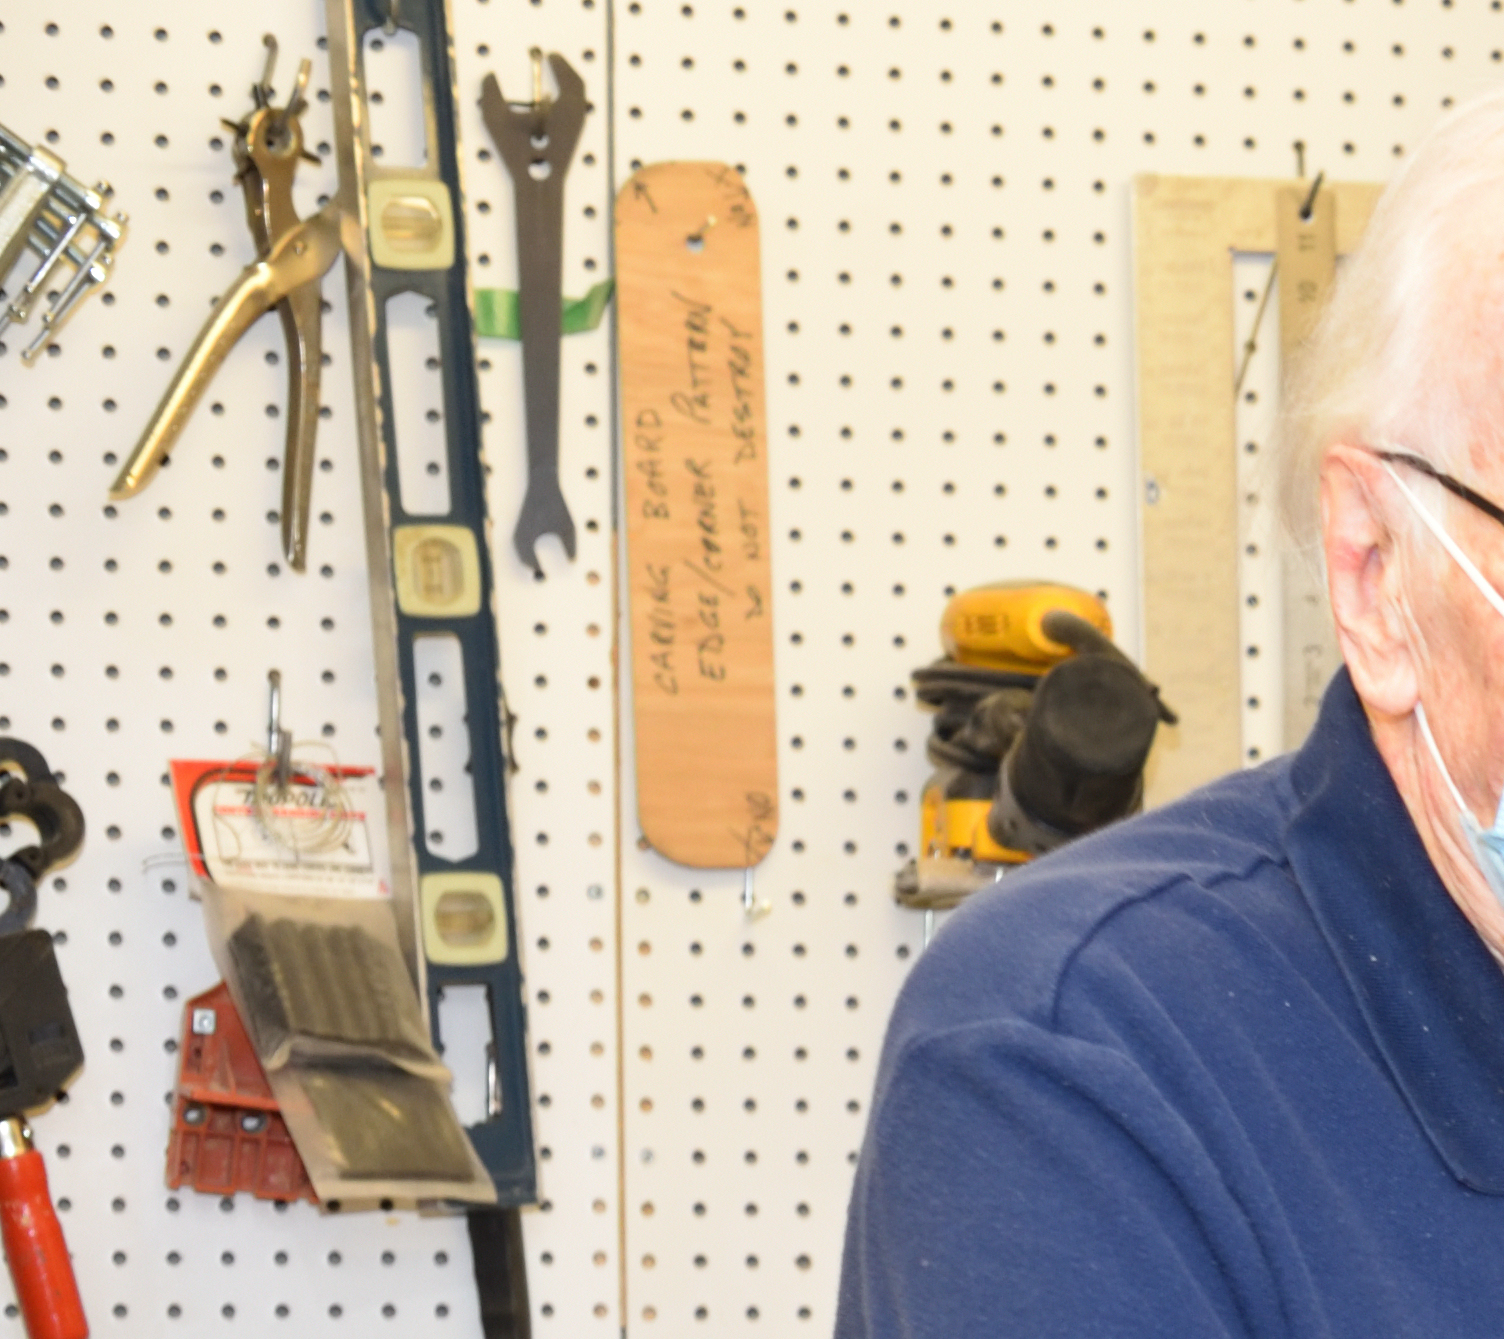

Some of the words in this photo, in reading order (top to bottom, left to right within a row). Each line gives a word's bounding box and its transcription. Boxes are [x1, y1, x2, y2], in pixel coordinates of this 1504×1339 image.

[669, 289, 713, 424] PATTERN
[719, 316, 757, 466] DESTROY
[634, 408, 670, 520] BOARD
[737, 498, 760, 560] NOT
[646, 563, 678, 696] CARVING
